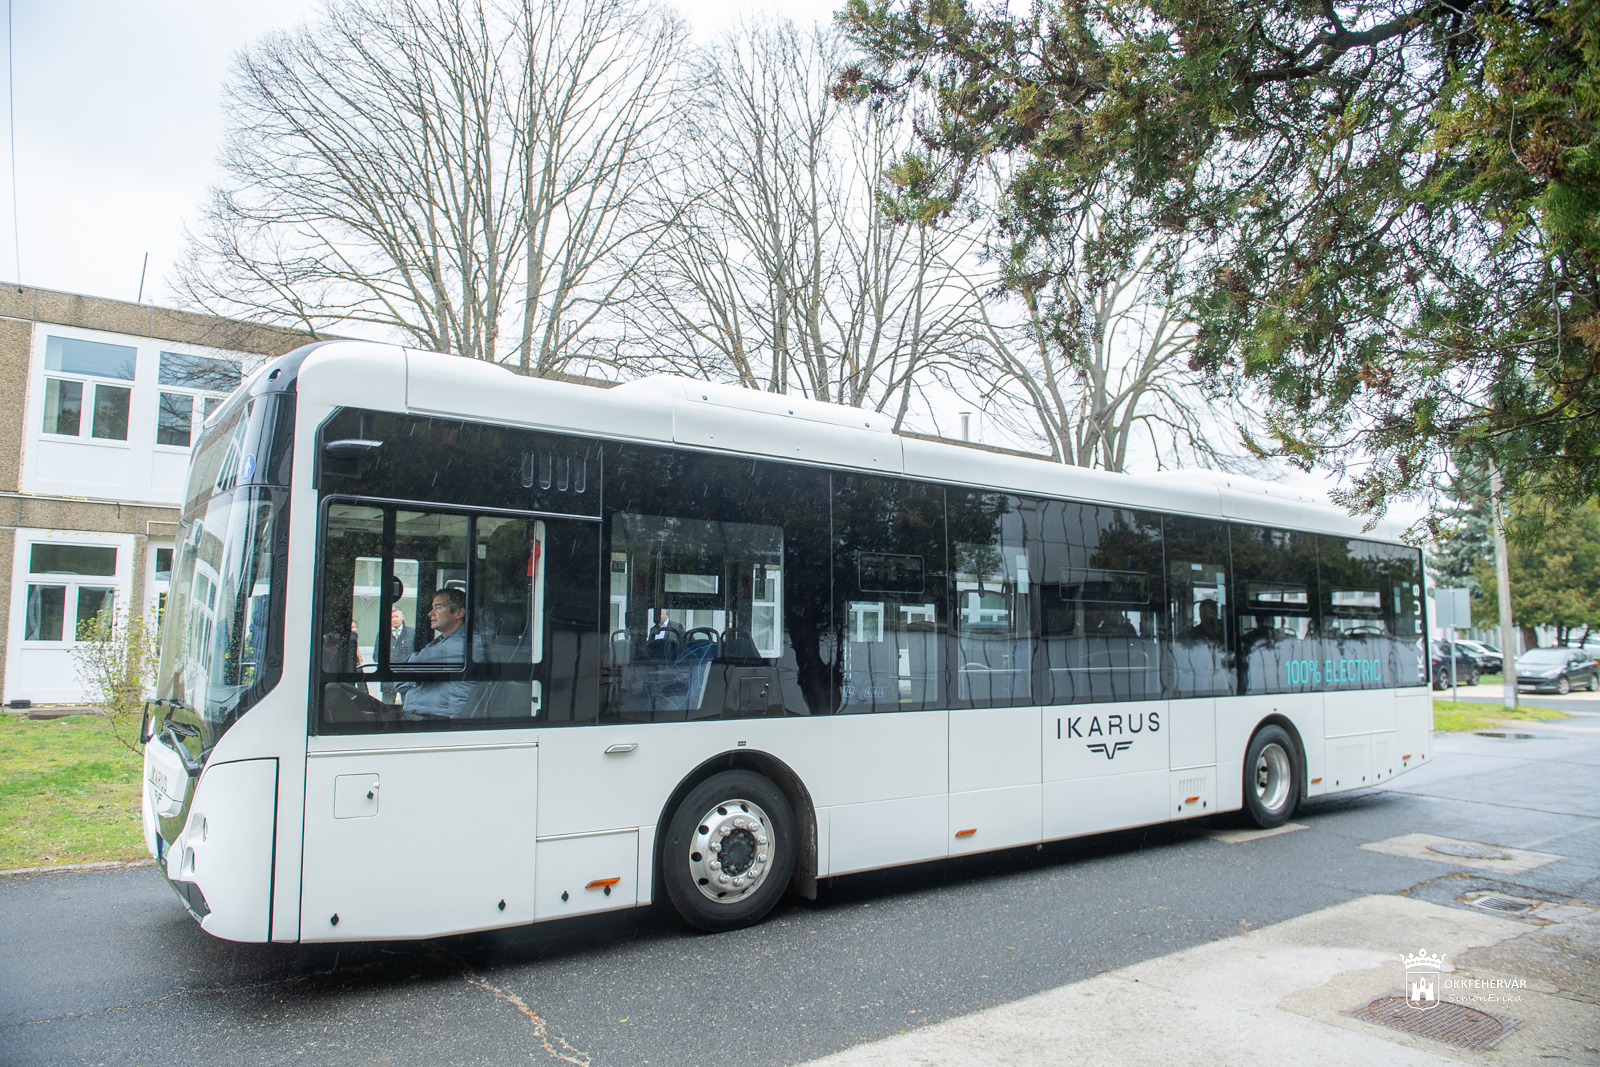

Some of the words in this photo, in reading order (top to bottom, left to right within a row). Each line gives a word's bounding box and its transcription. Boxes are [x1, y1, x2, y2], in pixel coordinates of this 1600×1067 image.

[1412, 584, 1424, 678] IKARUS
[1285, 660, 1321, 684] 100%
[1325, 659, 1381, 683] ELECTRIC
[1057, 712, 1160, 739] IKARUS
